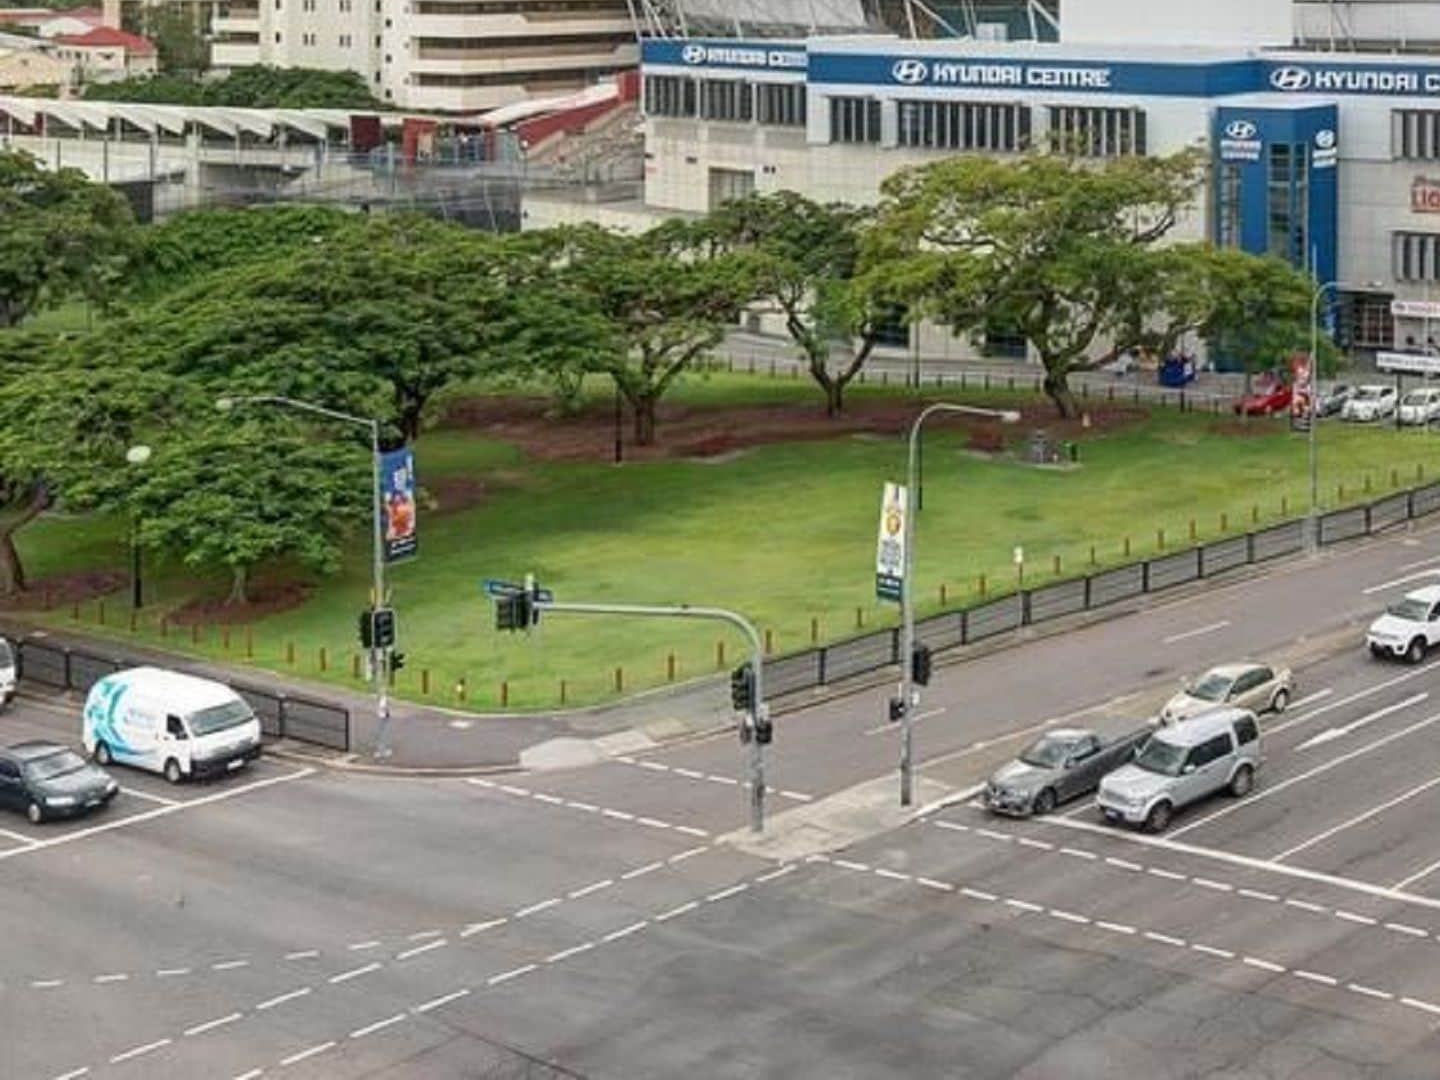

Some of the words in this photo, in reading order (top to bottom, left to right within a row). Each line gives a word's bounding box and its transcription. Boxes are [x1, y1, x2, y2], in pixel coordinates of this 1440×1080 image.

[932, 63, 1021, 84] HYUNDAI
[1026, 67, 1111, 87] CENTRE
[1315, 70, 1418, 91] HYUNDAI
